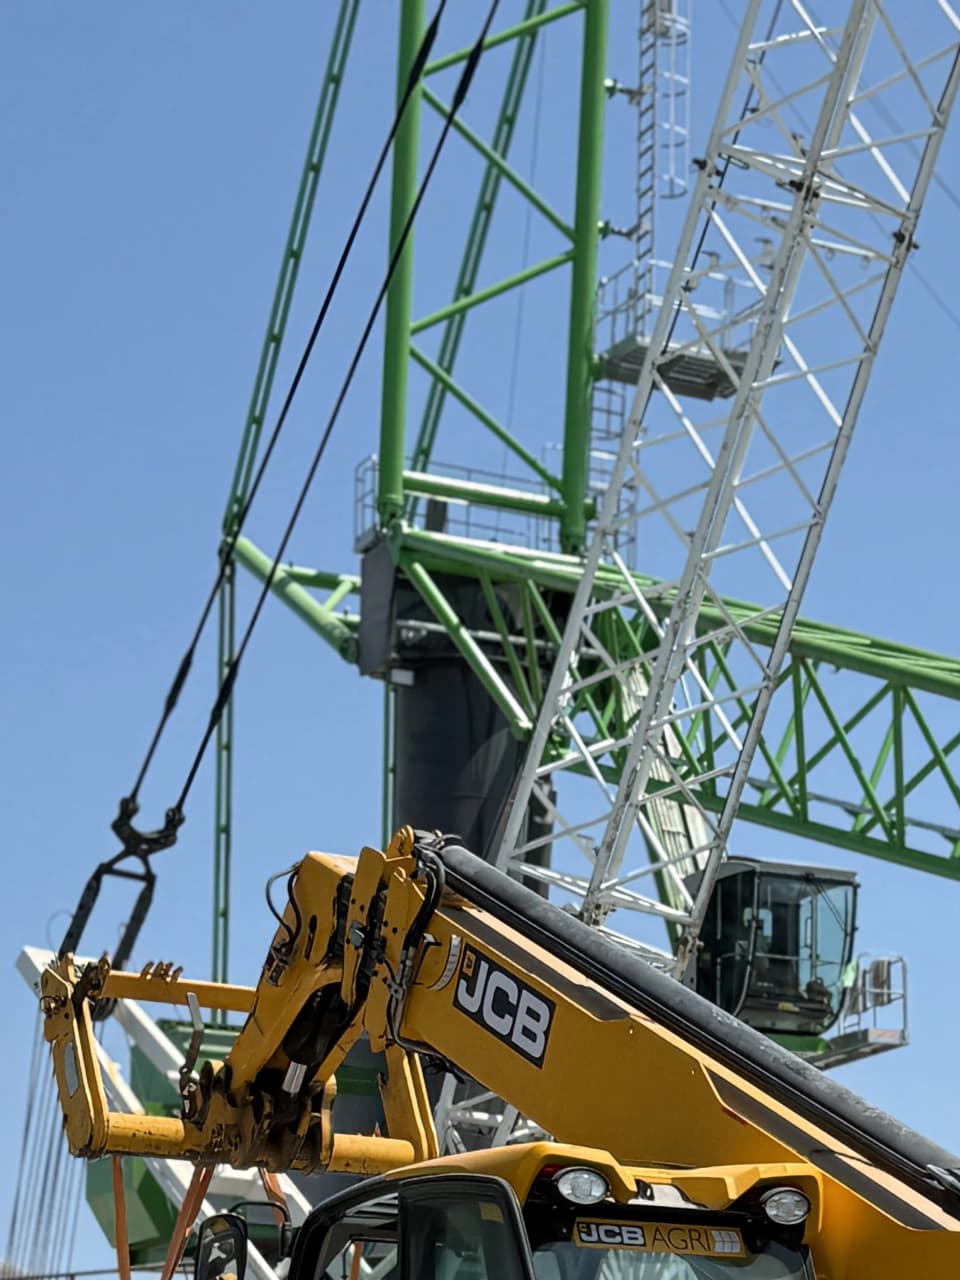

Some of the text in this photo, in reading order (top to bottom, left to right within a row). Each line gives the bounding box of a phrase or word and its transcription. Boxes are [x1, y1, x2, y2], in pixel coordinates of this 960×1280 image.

[457, 959, 551, 1059] JCB
[579, 1223, 712, 1251] JCB AGRI
